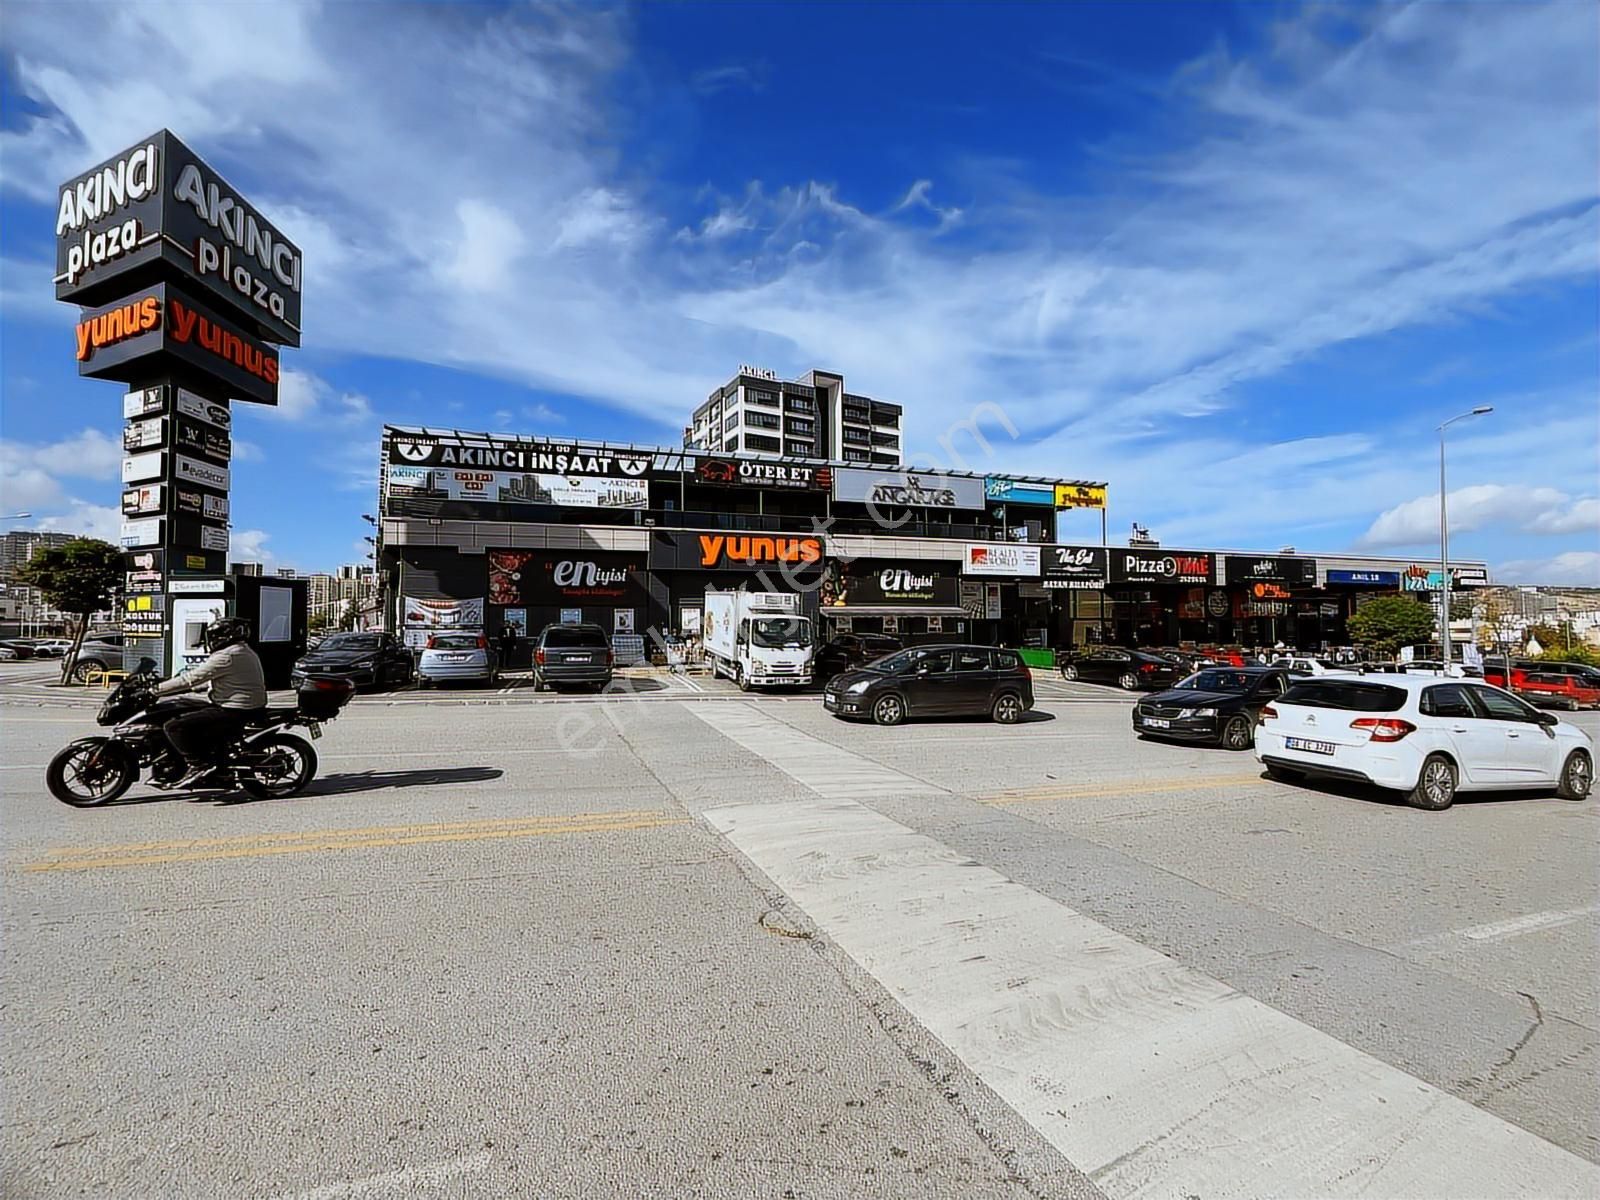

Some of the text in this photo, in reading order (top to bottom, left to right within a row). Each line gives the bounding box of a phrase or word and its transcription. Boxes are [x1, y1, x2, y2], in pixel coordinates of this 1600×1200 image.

[57, 144, 156, 236] AKINCI
[67, 219, 139, 284] plaza
[174, 164, 300, 292] AKINCI
[198, 238, 286, 320] plaza
[76, 295, 160, 361] yunus
[170, 300, 279, 385] yunus
[390, 469, 425, 480] AKINCI
[440, 447, 611, 474] AKINCI İNŞAAT
[739, 460, 812, 481] ÖTER ET
[699, 535, 823, 566] yunus
[1055, 548, 1075, 563] The
[1126, 555, 1165, 573] Pizza
